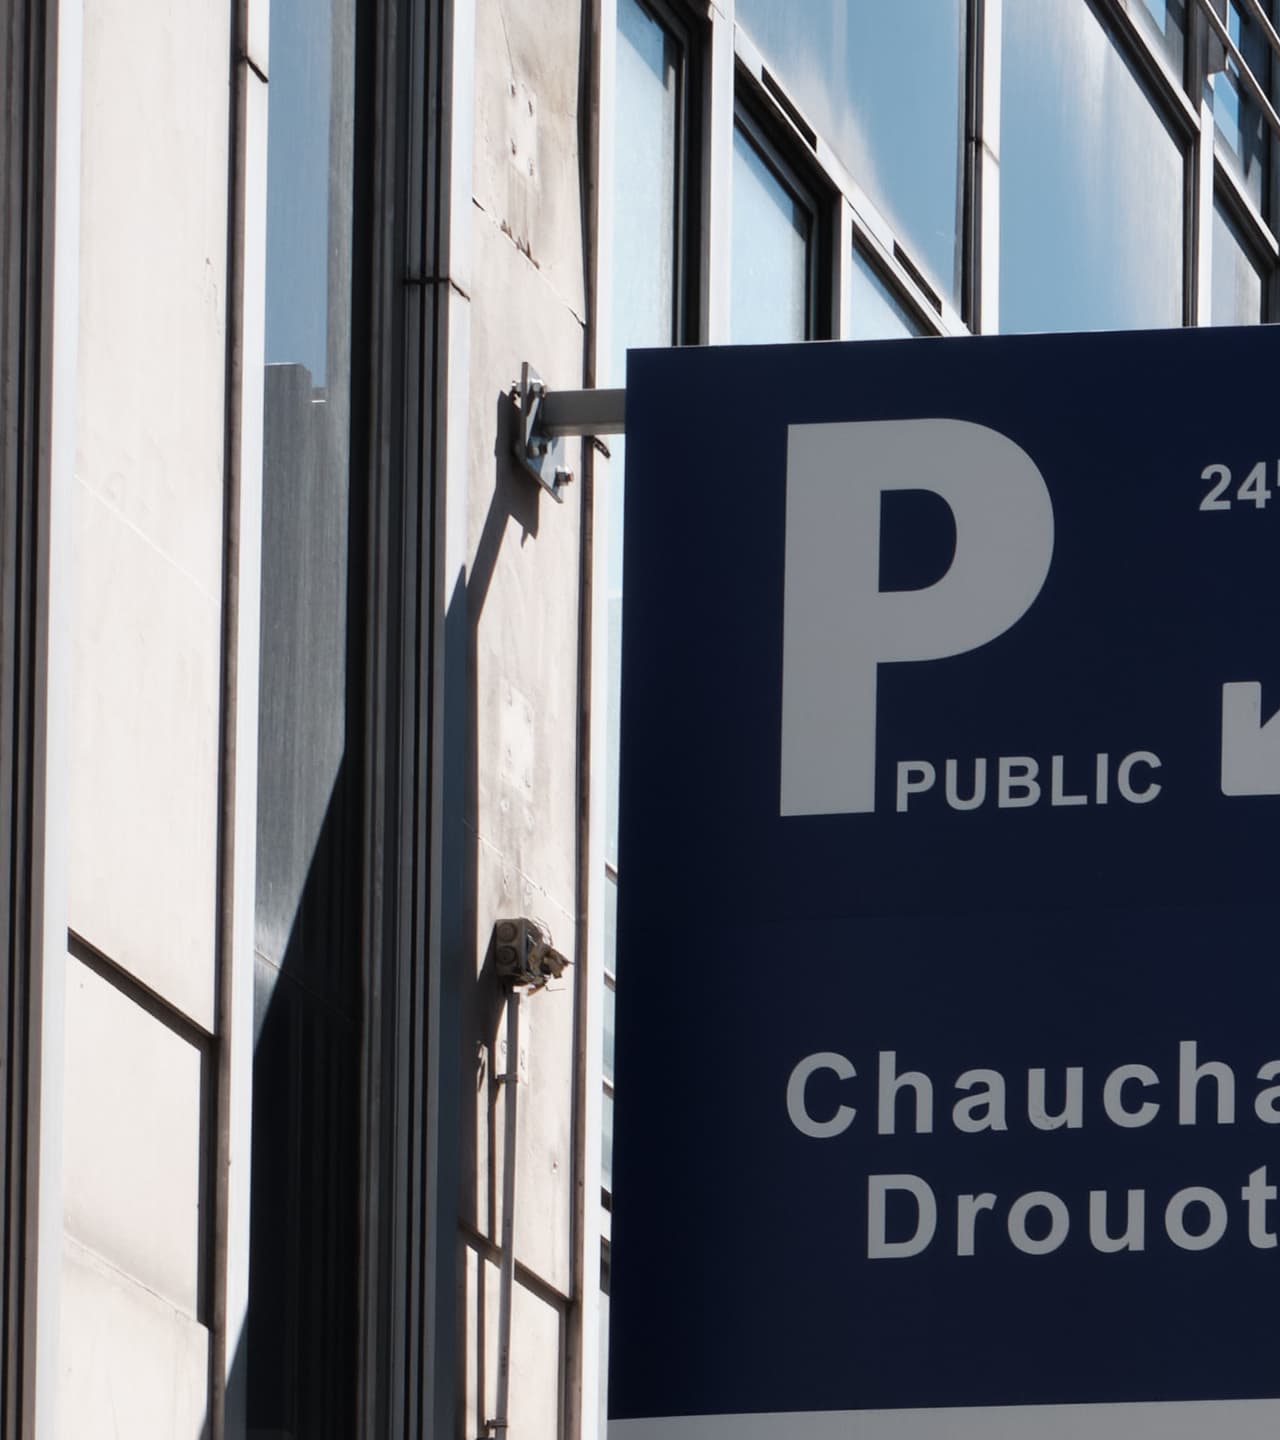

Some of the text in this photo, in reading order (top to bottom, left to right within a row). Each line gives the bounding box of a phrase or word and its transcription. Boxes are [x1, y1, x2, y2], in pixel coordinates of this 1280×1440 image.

[779, 418, 1054, 817] P
[894, 750, 1162, 813] PUBLIC
[867, 1165, 1278, 1259] Drouot
